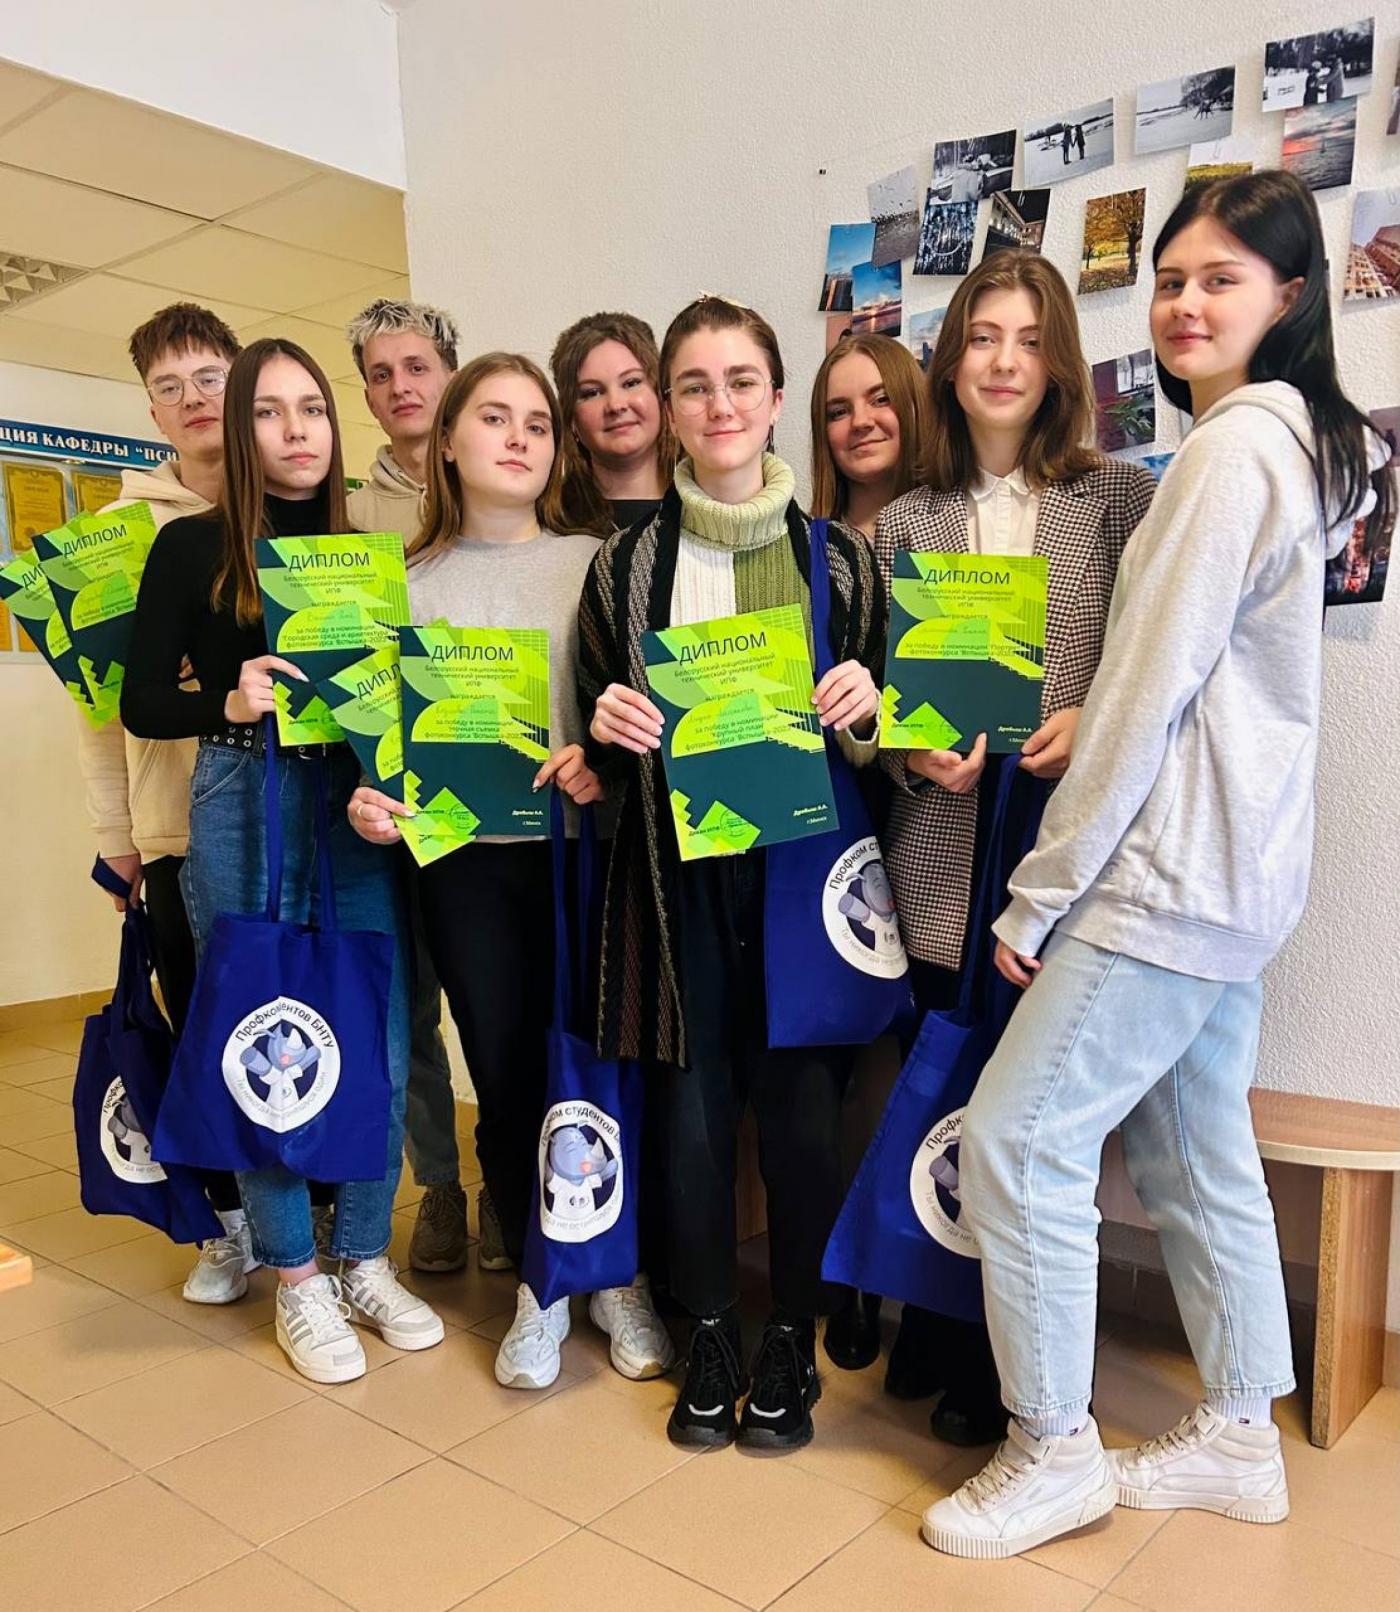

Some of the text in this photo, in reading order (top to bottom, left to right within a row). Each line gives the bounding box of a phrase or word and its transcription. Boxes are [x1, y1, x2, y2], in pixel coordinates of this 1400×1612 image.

[0, 427, 38, 446] ЦИЯ
[43, 432, 129, 458] КАФЕДРЫ
[62, 523, 127, 560] ДИПЛОМ
[289, 552, 370, 572] ДИПЛОМ
[923, 568, 1011, 585] ДИПЛОМ
[431, 645, 514, 663] ДИПЛОМ
[680, 631, 767, 665] ДИПЛОМ
[829, 844, 868, 889] Профком
[310, 1018, 335, 1049] БНТУ
[564, 1105, 615, 1135] студентов
[926, 1113, 965, 1150] Профк
